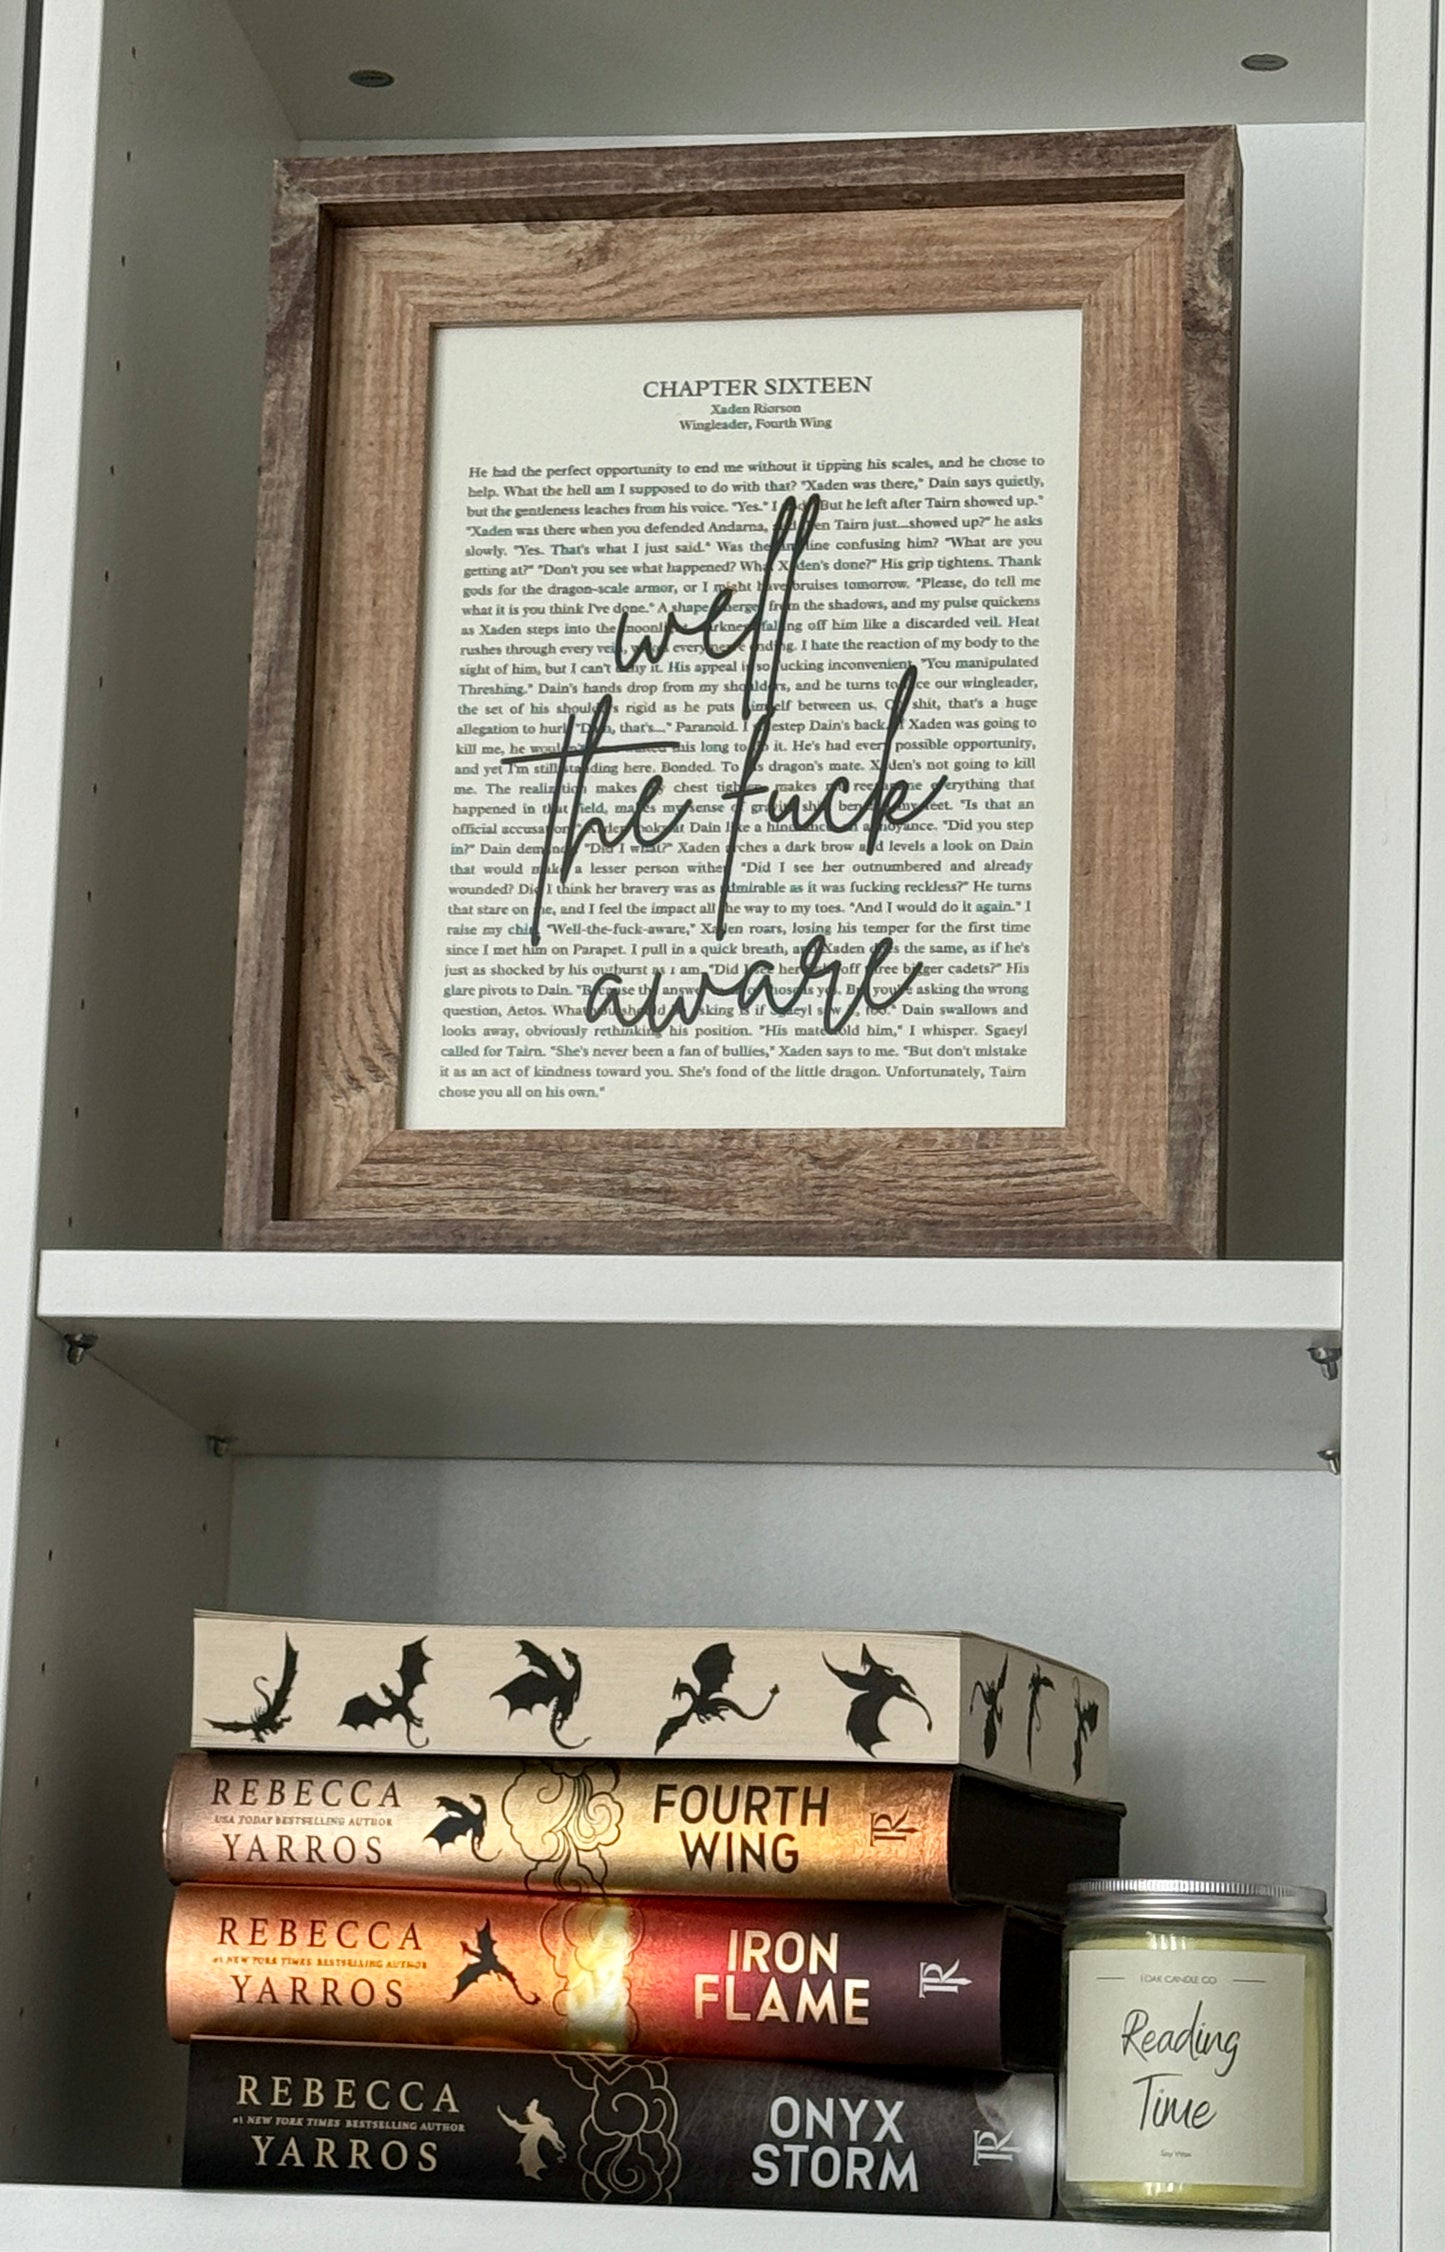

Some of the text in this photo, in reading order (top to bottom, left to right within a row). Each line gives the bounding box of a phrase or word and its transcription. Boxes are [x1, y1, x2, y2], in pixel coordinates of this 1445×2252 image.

[643, 375, 873, 398] CHAPTER SIXTEEN
[679, 416, 832, 432] Wingleader, Fourth Wing
[710, 402, 801, 416] Xaden Riorson
[467, 454, 1046, 480] He had the perfect opportunity to end me without it tipping his scales, and he chose to
[514, 525, 540, 536] was
[541, 522, 577, 536] there
[577, 522, 615, 535] when
[615, 524, 641, 537] you
[642, 519, 706, 535] defended
[706, 519, 769, 534] Andarna,
[832, 517, 870, 531] Tairn
[992, 514, 1012, 528] he
[1012, 513, 1044, 527] asks
[614, 493, 820, 719] well
[806, 614, 1040, 632] off him like a discarded veil. Heat
[536, 680, 579, 695] Dain's
[581, 680, 623, 695] hands
[625, 680, 659, 696] drop
[661, 679, 695, 694] from
[697, 682, 720, 696] my
[716, 665, 947, 940] fuck
[500, 693, 692, 946] the
[887, 837, 1034, 852] levels a look on Dain
[788, 883, 804, 894] as
[806, 879, 818, 894] it
[819, 883, 846, 893] was
[848, 879, 901, 896] fucking
[971, 879, 994, 893] He
[995, 880, 1033, 892] turns
[445, 922, 478, 936] raise
[481, 925, 503, 939] my
[747, 923, 787, 936] roars,
[790, 920, 833, 937] losing
[835, 919, 858, 934] his
[861, 922, 911, 937] temper
[914, 919, 937, 934] for
[939, 920, 963, 934] the
[966, 919, 996, 934] first
[999, 919, 1031, 933] time
[585, 934, 923, 1034] aware
[439, 1043, 480, 1057] called
[481, 1043, 503, 1057] for
[504, 1043, 547, 1057] Tairn.
[548, 1043, 590, 1058] "She's
[590, 1046, 630, 1057] never
[630, 1043, 664, 1058] been
[665, 1047, 676, 1057] a
[677, 1043, 702, 1058] fan
[702, 1043, 720, 1058] of
[776, 1043, 823, 1058] Xaden
[824, 1046, 854, 1060] says
[856, 1045, 872, 1057] to
[873, 1046, 900, 1057] me.
[935, 1043, 972, 1057] don't
[973, 1042, 1028, 1057] mistake
[438, 1063, 1027, 1081] it as an act of kindness toward you. She's fond of the little dragon. Unfortunately, Tairn
[437, 1084, 477, 1098] chose
[476, 1087, 503, 1101] you
[504, 1084, 523, 1098] all
[523, 1088, 543, 1098] on
[544, 1084, 566, 1098] his
[210, 1777, 401, 1808] REBECCA
[653, 1783, 829, 1826] FOURTH
[214, 1814, 393, 1827] USA TODAY BESTSELLING AUTHOR
[222, 1833, 382, 1864] YARROS
[679, 1830, 800, 1874] WING
[217, 1916, 422, 1950] REBECCA
[727, 1929, 839, 1975] IRON
[230, 1974, 403, 2008] YARROS
[1164, 1975, 1199, 1984] CANDLE
[694, 1973, 870, 2026] FLAME
[1121, 2000, 1241, 2077] Reading
[236, 2074, 460, 2113] REBECCA
[1132, 2073, 1218, 2131] Time
[246, 2115, 272, 2125] NEW
[275, 2116, 304, 2127] YORK
[306, 2117, 341, 2128] TIMES
[345, 2119, 417, 2130] BESTSELLING
[419, 2122, 466, 2132] AUTHOR
[770, 2095, 905, 2143] ONYX
[251, 2135, 438, 2172] YARROS
[751, 2142, 919, 2192] STORM
